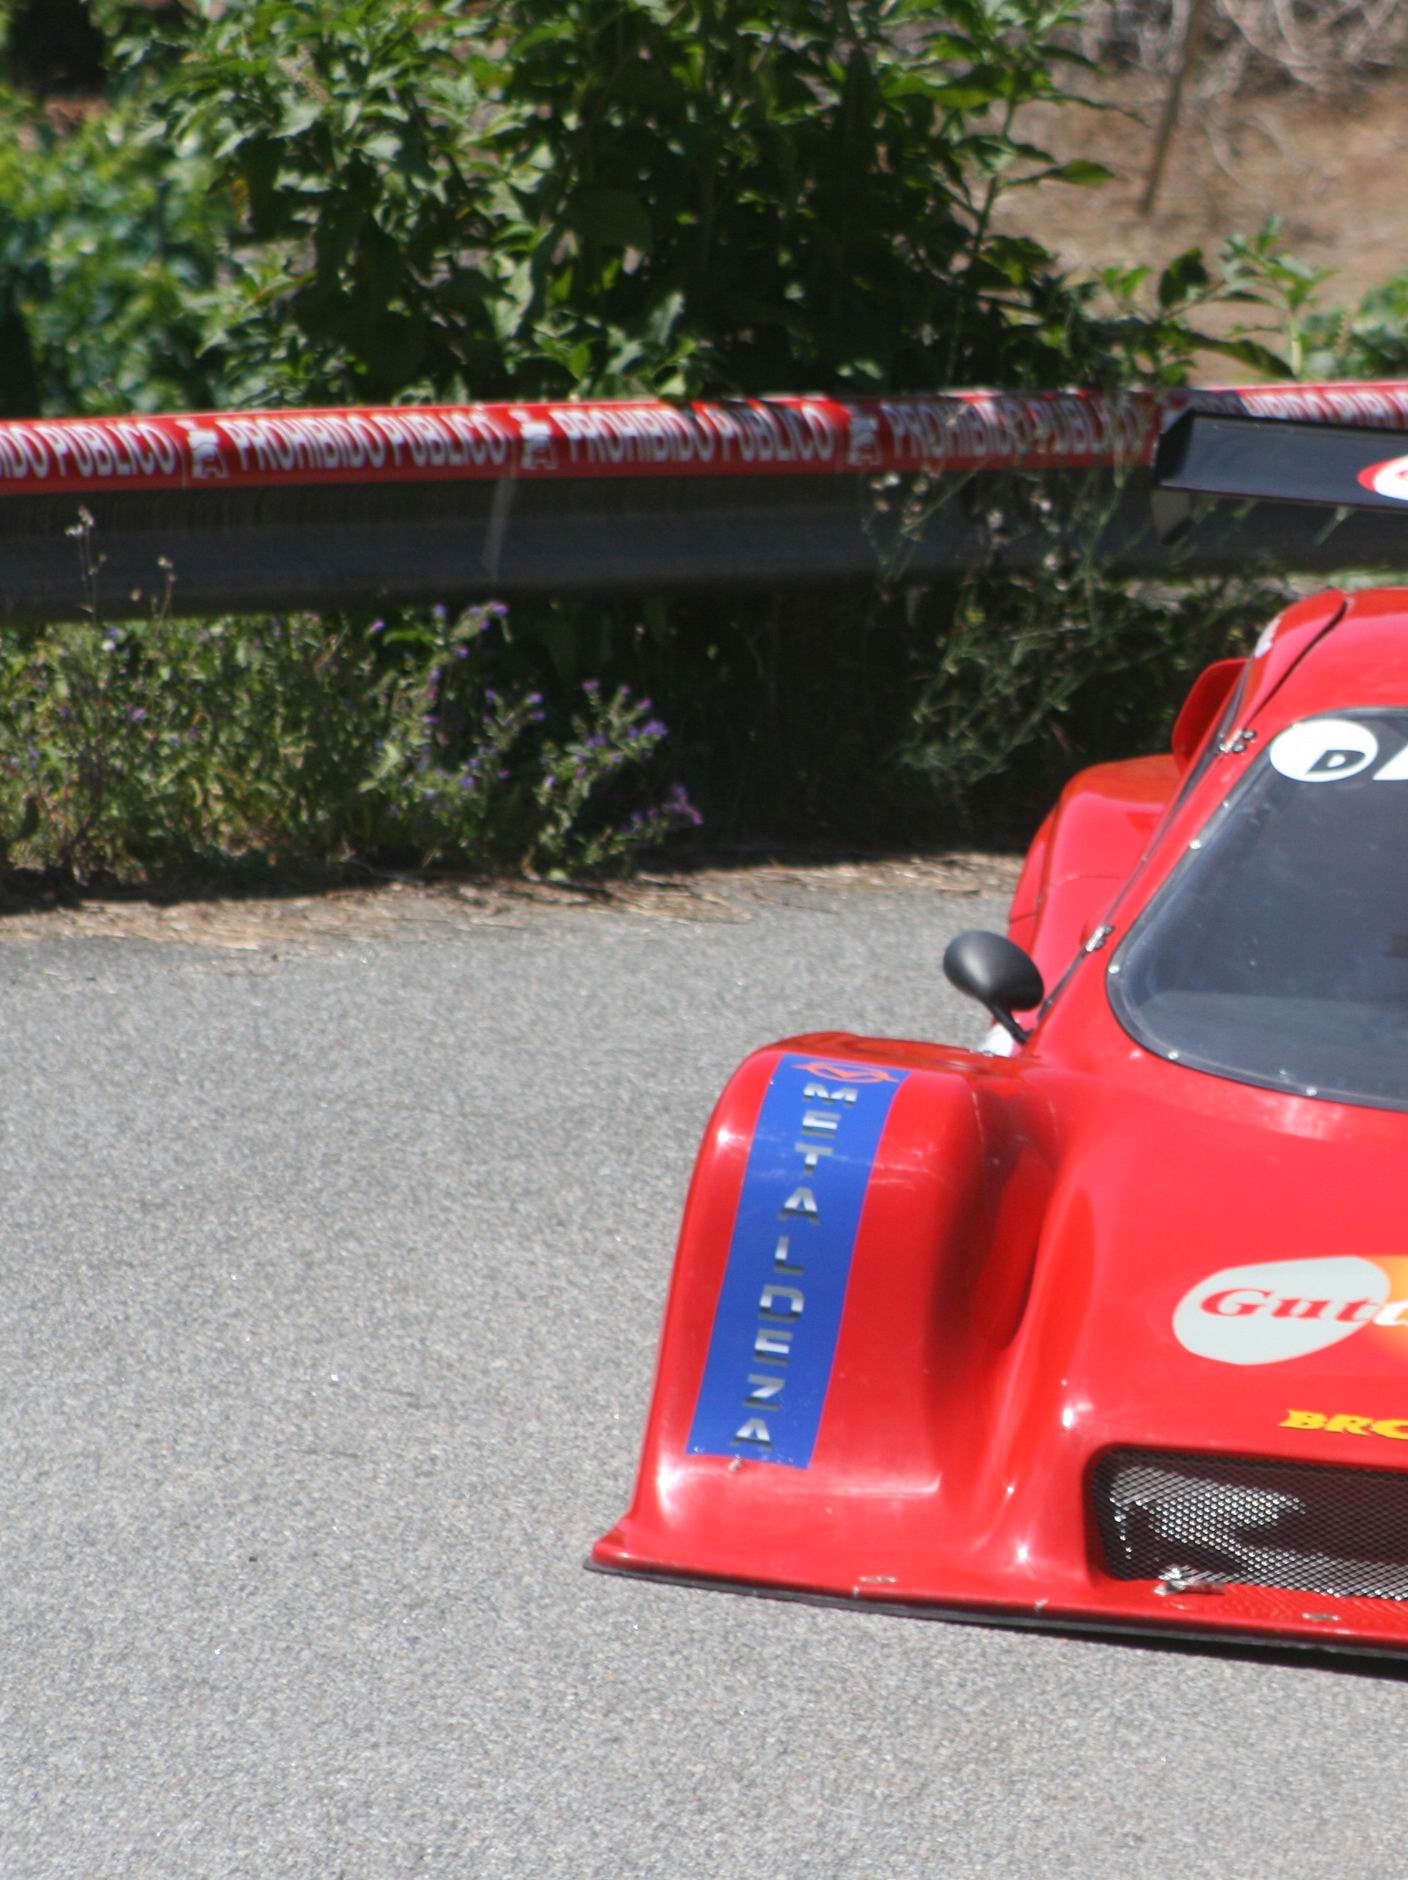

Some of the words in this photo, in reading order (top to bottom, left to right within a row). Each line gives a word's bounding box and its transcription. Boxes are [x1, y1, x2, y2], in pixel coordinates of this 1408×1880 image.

[33, 422, 176, 479] PUBLICO
[215, 415, 386, 472] PROHIBIDO
[372, 411, 508, 467] PUBLICO
[548, 407, 715, 465] PROHIBIDO
[702, 402, 836, 462] PUBLICO
[731, 1082, 858, 1452] METALDEZA
